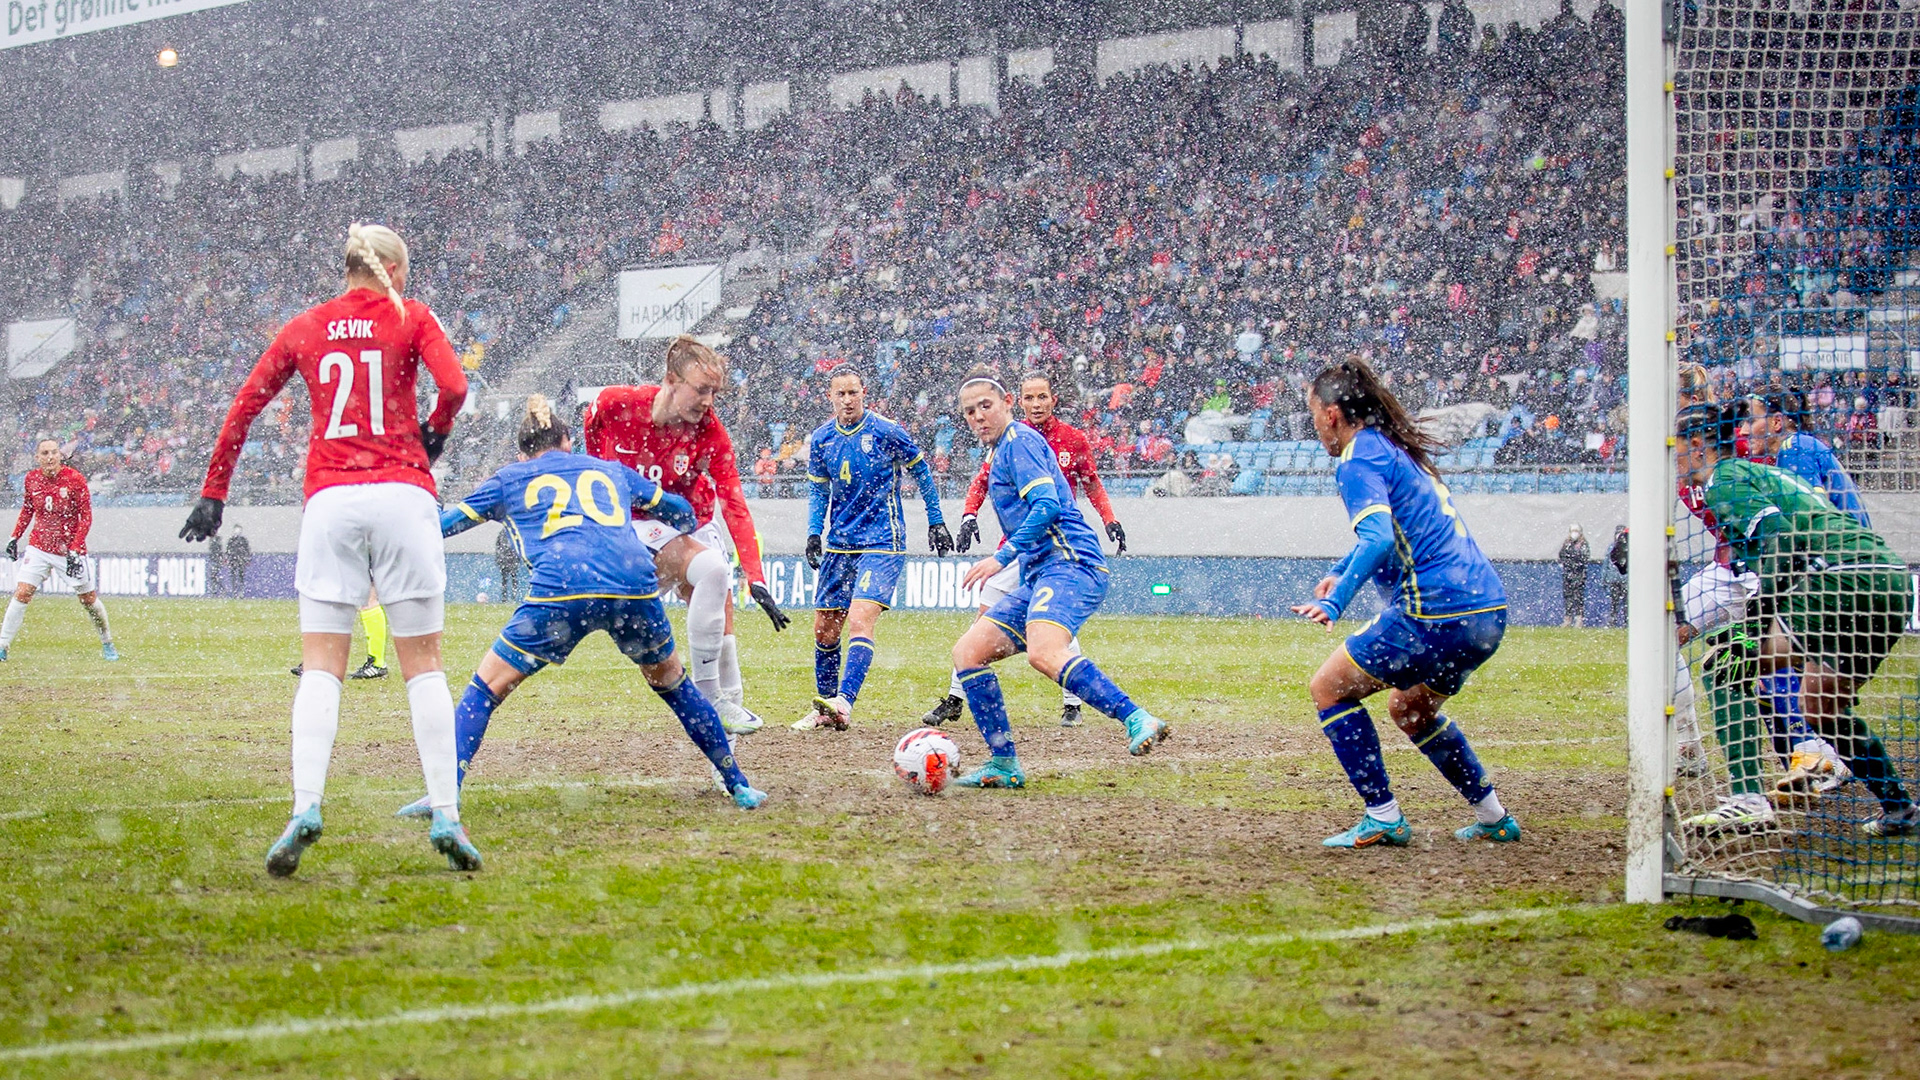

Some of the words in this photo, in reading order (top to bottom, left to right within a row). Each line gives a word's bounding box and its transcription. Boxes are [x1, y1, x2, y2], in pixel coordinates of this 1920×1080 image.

[9, 1, 47, 36] Det
[327, 319, 374, 341] SÆVIK
[319, 349, 386, 440] 21
[840, 460, 852, 485] 4
[45, 495, 53, 511] 8
[524, 469, 626, 540] 20
[858, 570, 872, 593] 4
[1031, 586, 1055, 612] 2
